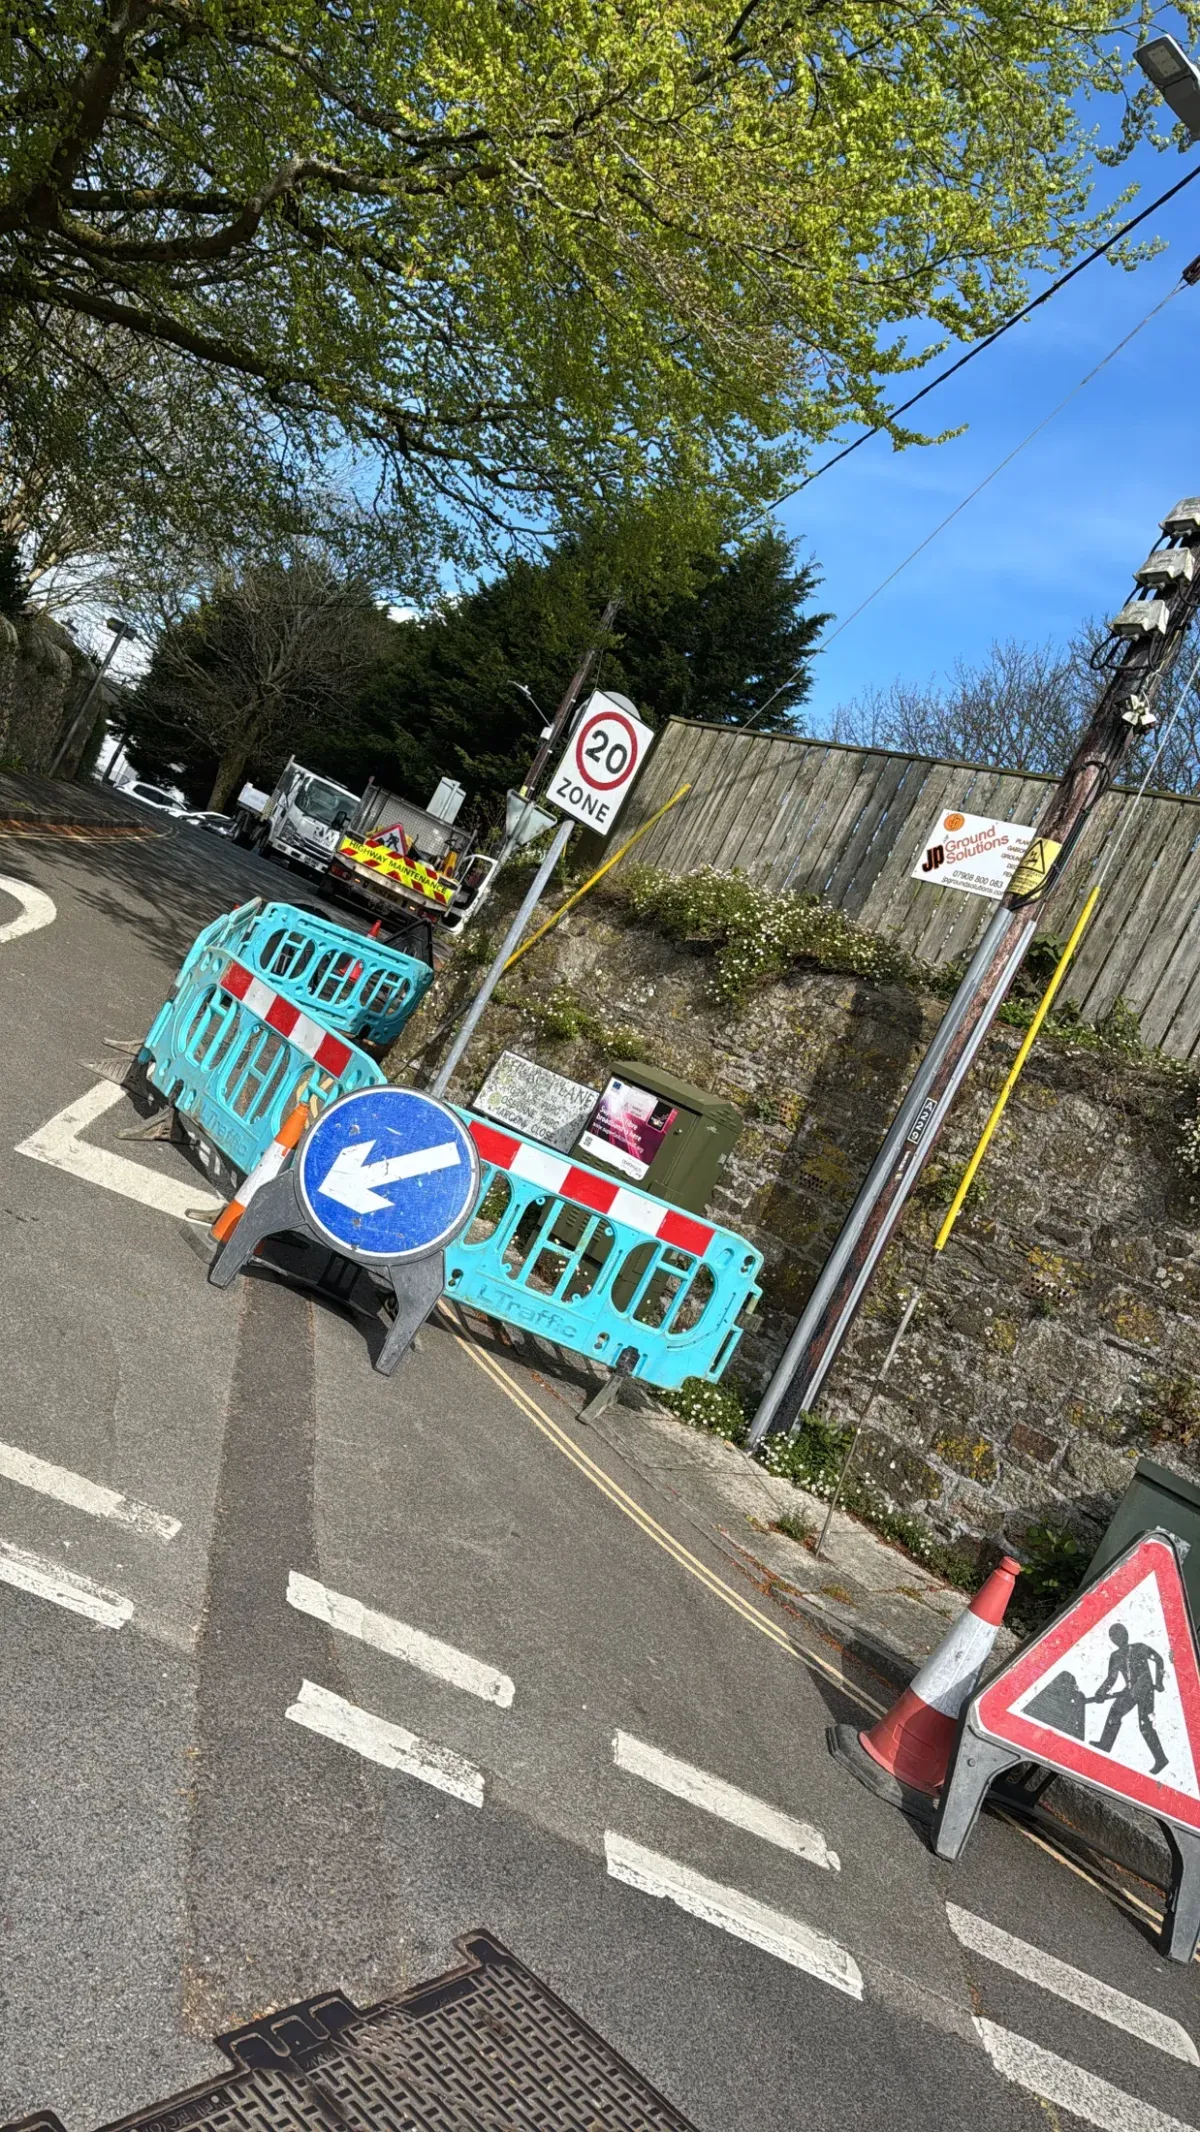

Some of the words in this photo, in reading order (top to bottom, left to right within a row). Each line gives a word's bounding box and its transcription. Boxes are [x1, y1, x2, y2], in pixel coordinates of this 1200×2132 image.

[585, 730, 627, 774] 20
[556, 777, 610, 823] ZONE
[945, 825, 996, 852] Ground
[1016, 838, 1030, 846] PLAN
[350, 840, 387, 862] HIGHWAY
[389, 860, 447, 894] MAINTENANCE
[922, 844, 945, 872] JP
[946, 835, 1009, 864] Solutions
[974, 876, 988, 884] 800
[557, 1081, 595, 1109] LANE
[529, 1123, 555, 1142] CLOSE
[538, 1114, 560, 1130] PARC
[144, 2098, 231, 2132] TELECO
